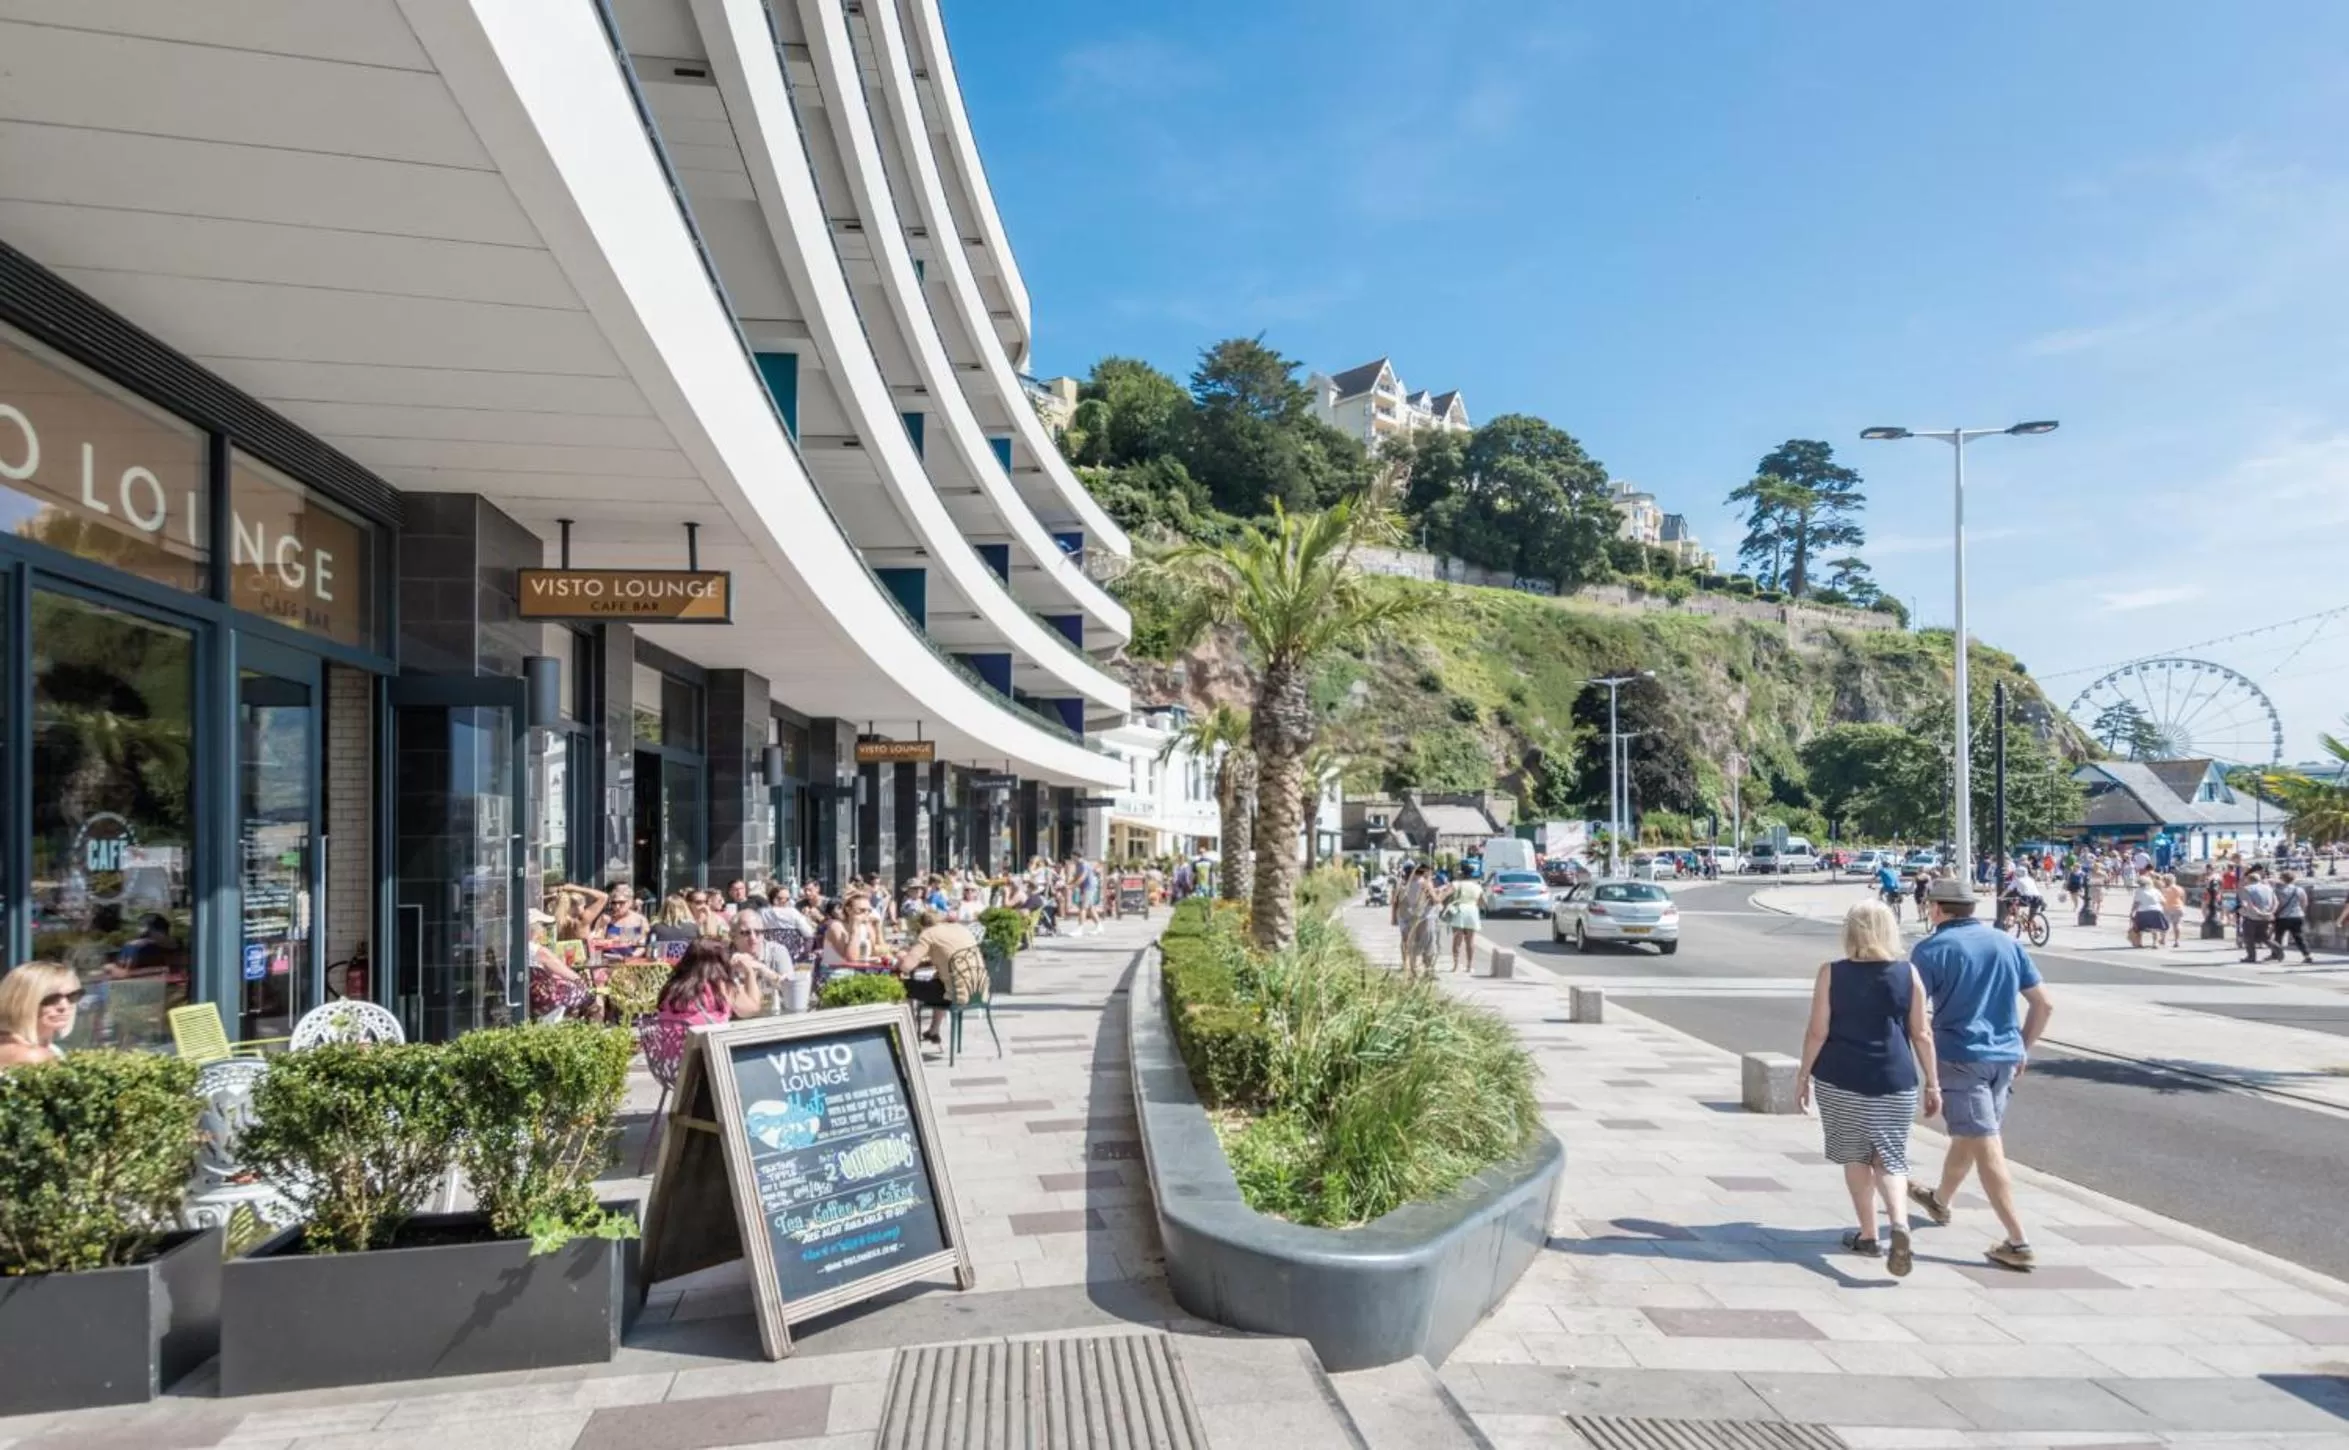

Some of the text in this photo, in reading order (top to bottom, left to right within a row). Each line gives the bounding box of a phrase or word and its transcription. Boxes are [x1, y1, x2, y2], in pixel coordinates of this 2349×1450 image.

[530, 578, 720, 599] VISTO LOUNGE
[590, 601, 659, 612] CAFE BAR
[859, 744, 931, 754] VISTO LOUNGE
[767, 1043, 852, 1075] VISTO
[782, 1068, 850, 1093] LOUNGE
[824, 1163, 838, 1181] 2
[774, 1211, 804, 1236] Tea
[812, 1199, 854, 1223] Coffee
